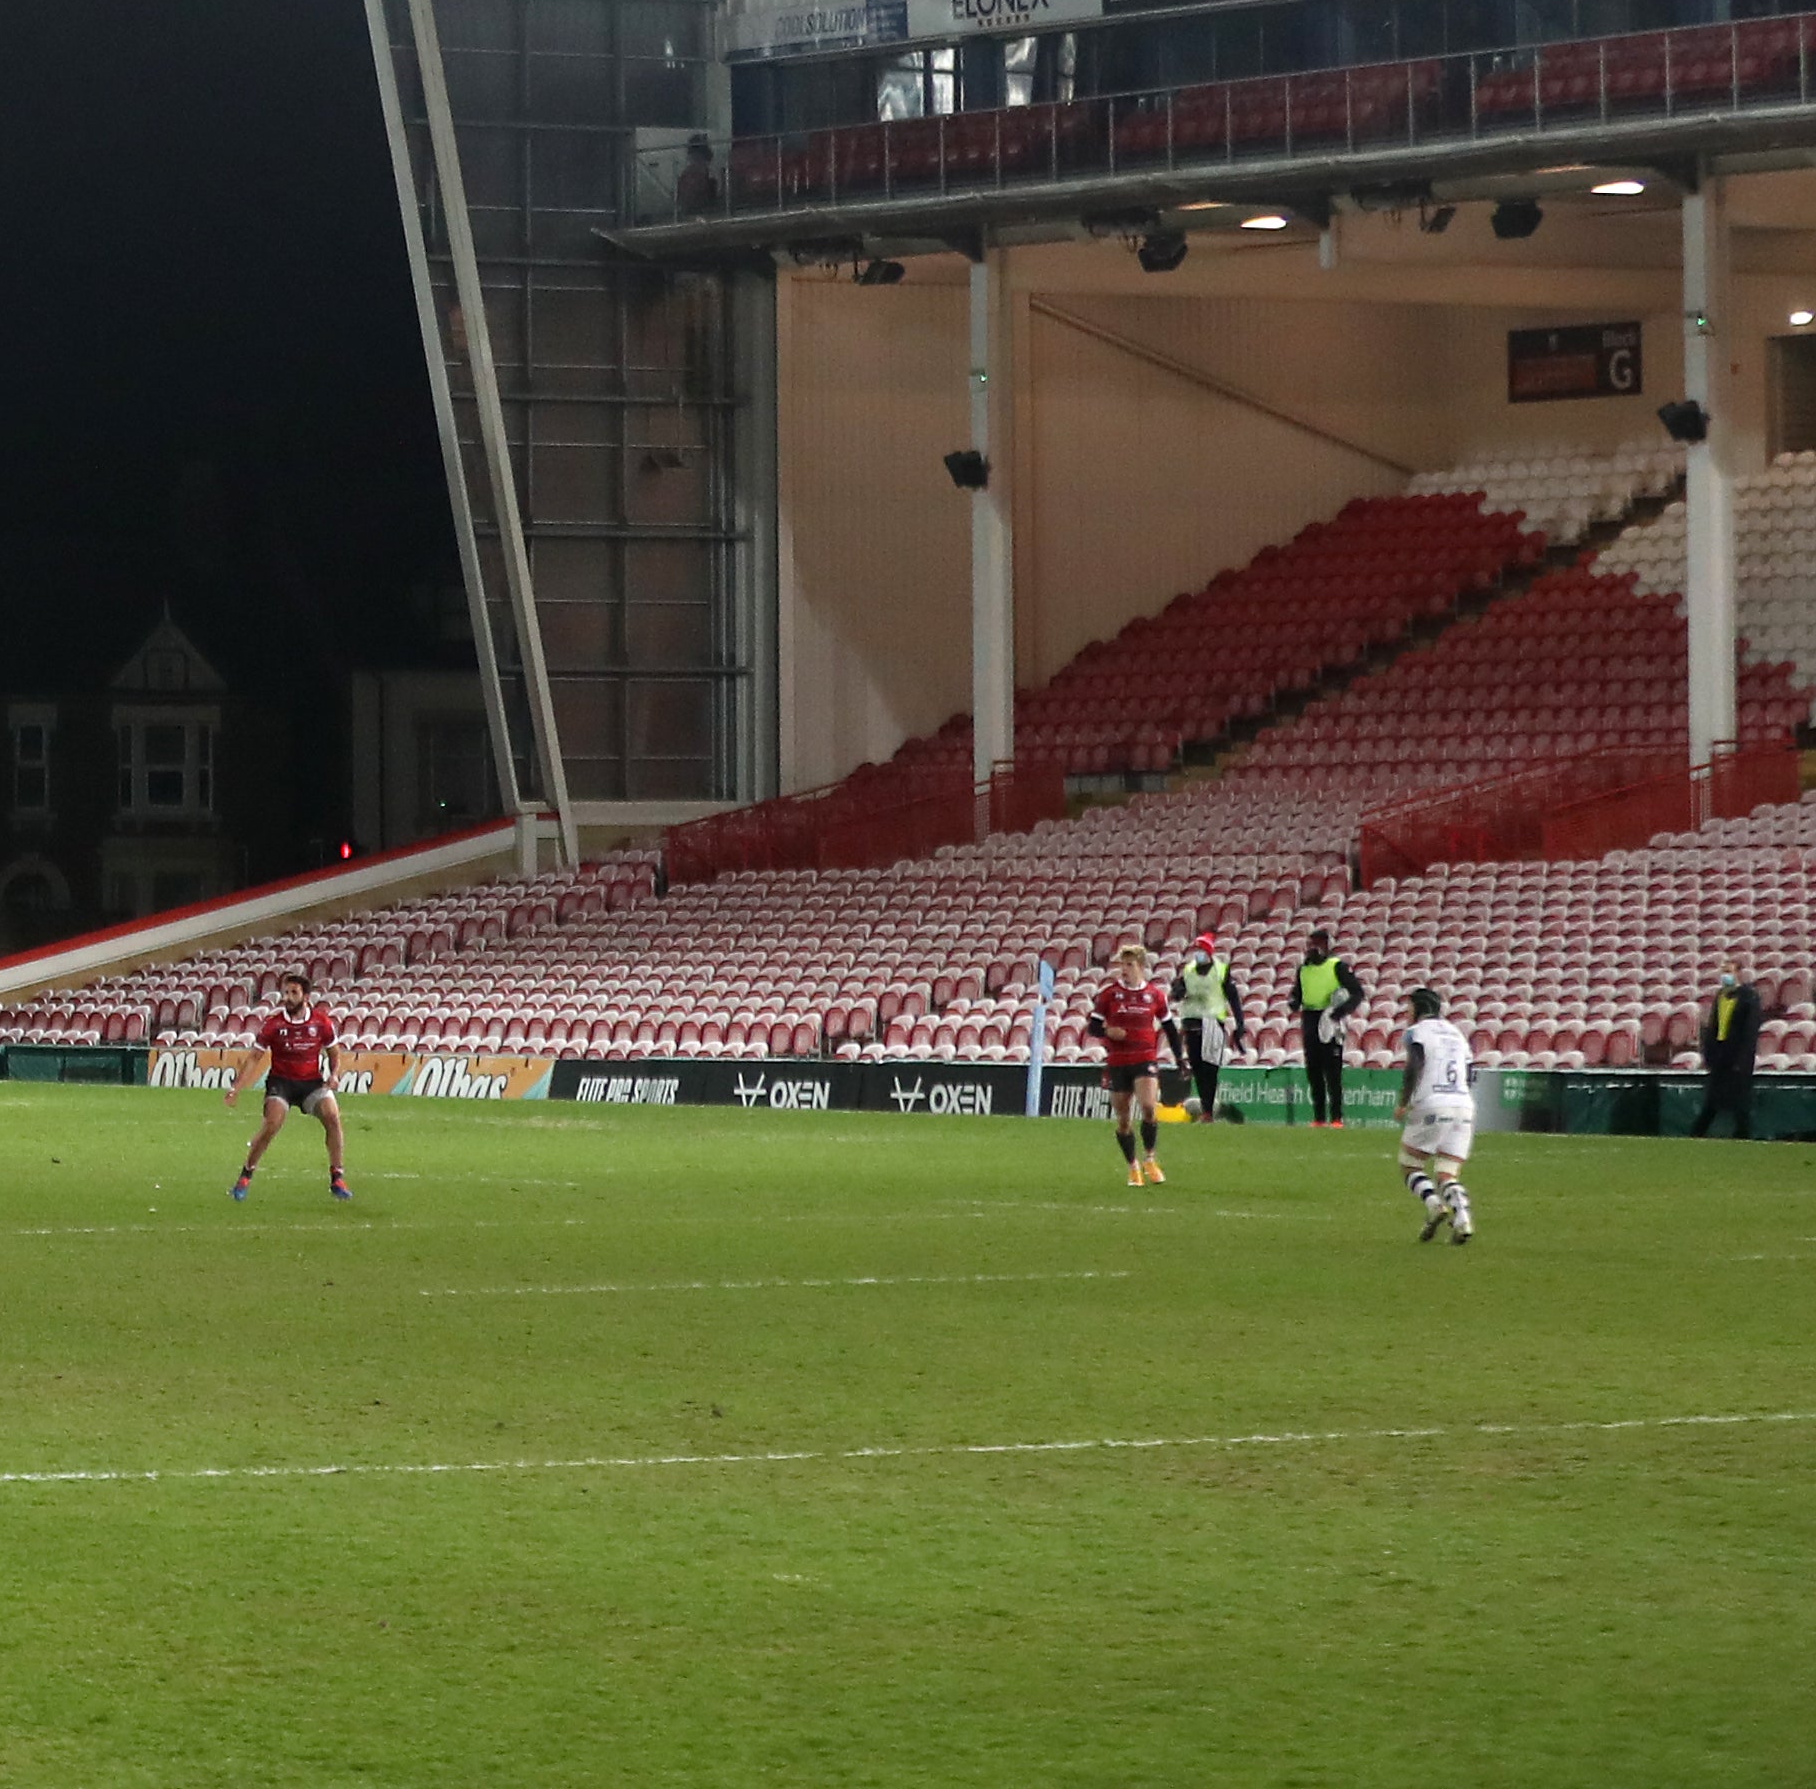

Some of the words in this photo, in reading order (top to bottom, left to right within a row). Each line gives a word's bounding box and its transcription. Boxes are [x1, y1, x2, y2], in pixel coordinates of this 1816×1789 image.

[1609, 349, 1633, 390] G
[1446, 1059, 1458, 1085] 6
[576, 1076, 607, 1103] ELITE
[631, 1077, 680, 1105] SPORTS
[769, 1081, 831, 1110] OXEN
[928, 1083, 992, 1115] OXEN
[1050, 1085, 1084, 1117] ELITE
[1218, 1081, 1253, 1104] ffield
